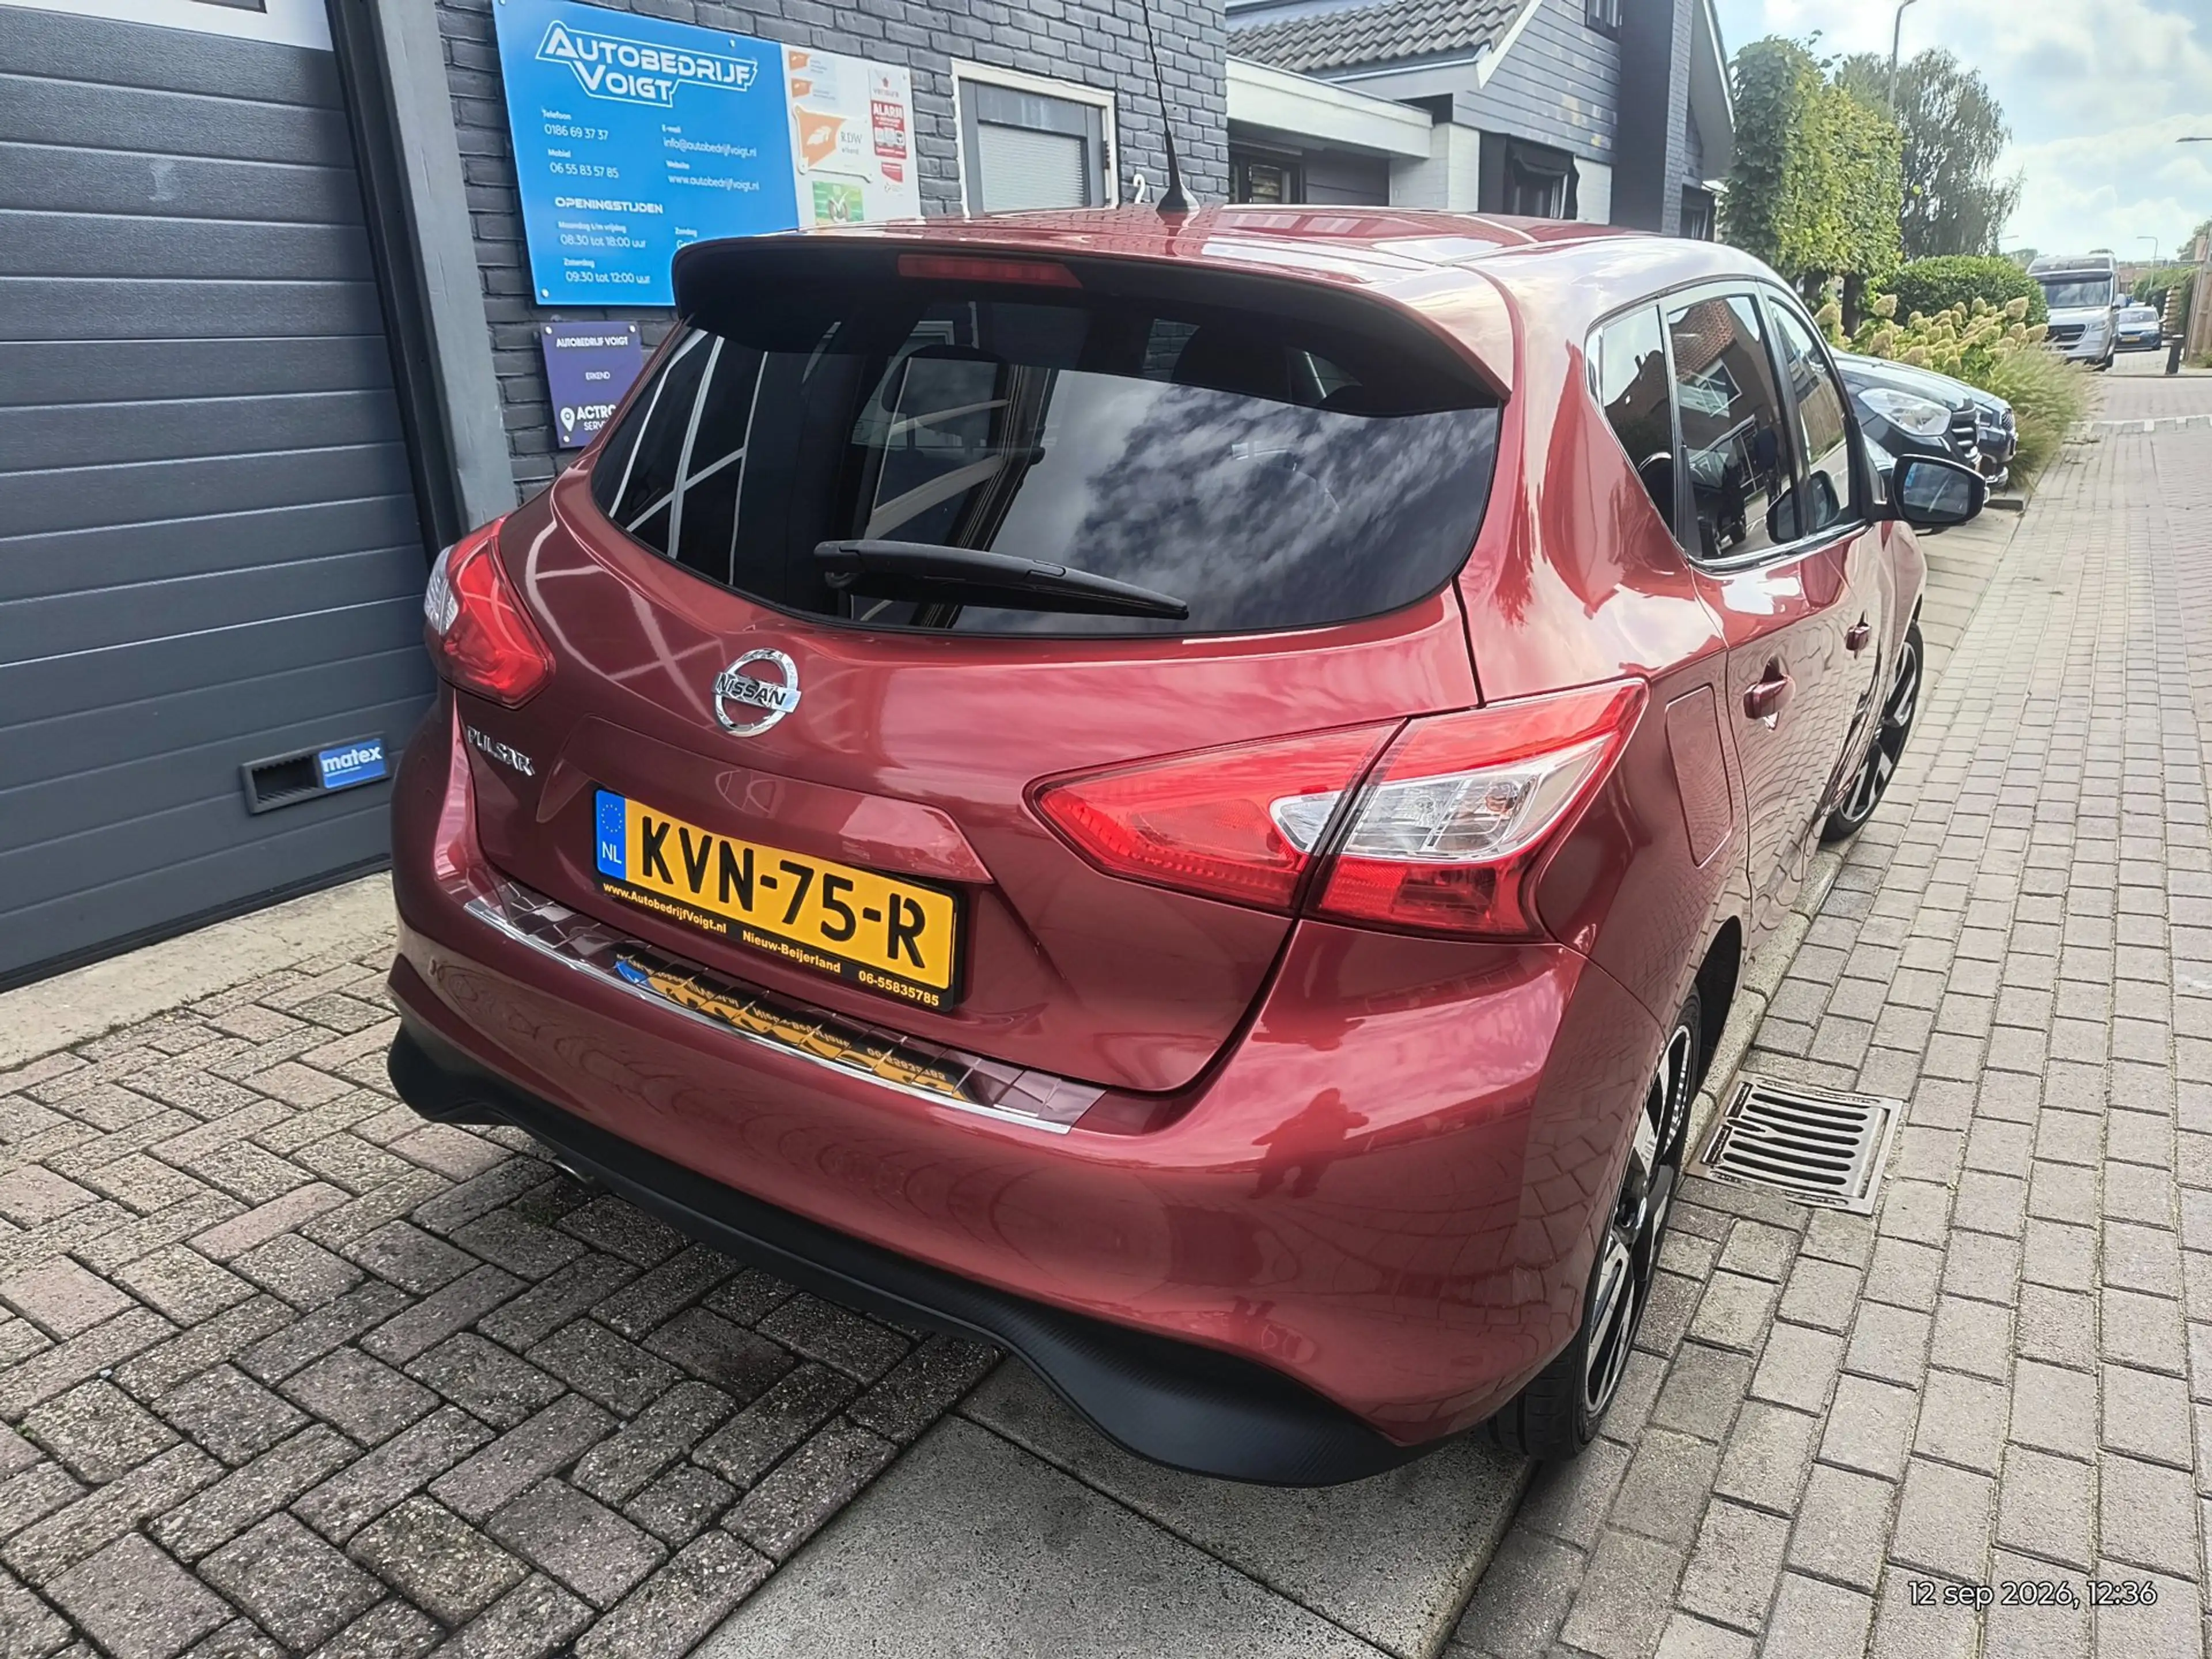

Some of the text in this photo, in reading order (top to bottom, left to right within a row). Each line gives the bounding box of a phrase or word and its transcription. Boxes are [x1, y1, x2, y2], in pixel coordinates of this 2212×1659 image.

[546, 27, 750, 85] AUTOBEDRIJF
[574, 60, 673, 100] VOIGT
[873, 103, 903, 119] ALARM
[544, 123, 608, 140] 0186 69 37 37
[841, 131, 863, 144] RDW
[663, 137, 757, 158] info@autobedrijfvoigt.nl
[550, 162, 620, 179] 06 55 83 57 85
[668, 175, 760, 192] www.autobedrijfvoigt.nl
[555, 196, 663, 214] OPENINGSTIJDEN
[590, 236, 605, 247] tot
[632, 240, 646, 248] uur
[595, 273, 610, 283] tot
[635, 275, 651, 284] uur
[556, 336, 628, 348] AUTOBEDRIJF VOIGT
[585, 371, 611, 381] ERKEND
[717, 673, 786, 706] NISSAN
[321, 746, 382, 772] matex
[467, 725, 536, 777] PULSAR
[602, 840, 622, 865] NL
[642, 815, 926, 969] KVN-75-R
[603, 882, 940, 1007] www.AutobedrijfVoigt.nl Nieuw-Beijerland 06-55835785
